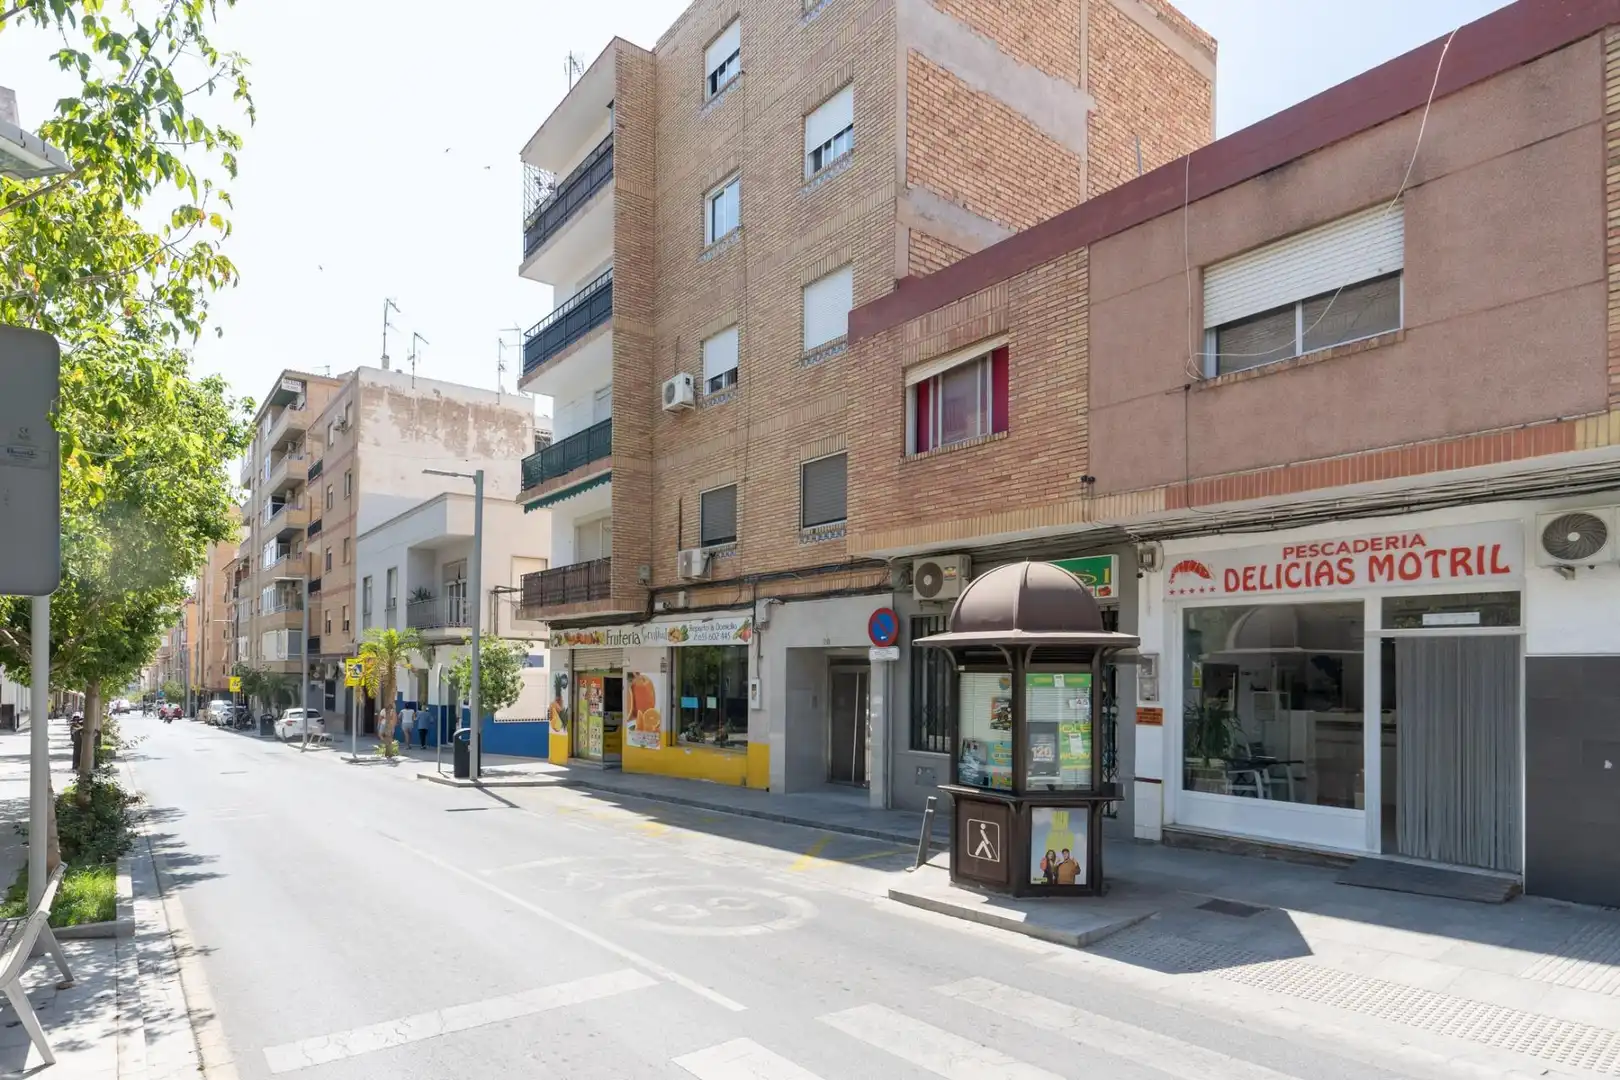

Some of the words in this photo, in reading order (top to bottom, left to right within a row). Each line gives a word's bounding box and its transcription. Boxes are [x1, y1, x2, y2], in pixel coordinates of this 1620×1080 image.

[1283, 533, 1427, 560] PESCADERIA
[1223, 557, 1356, 593] DELICIAS
[1368, 543, 1511, 583] MOTRIL
